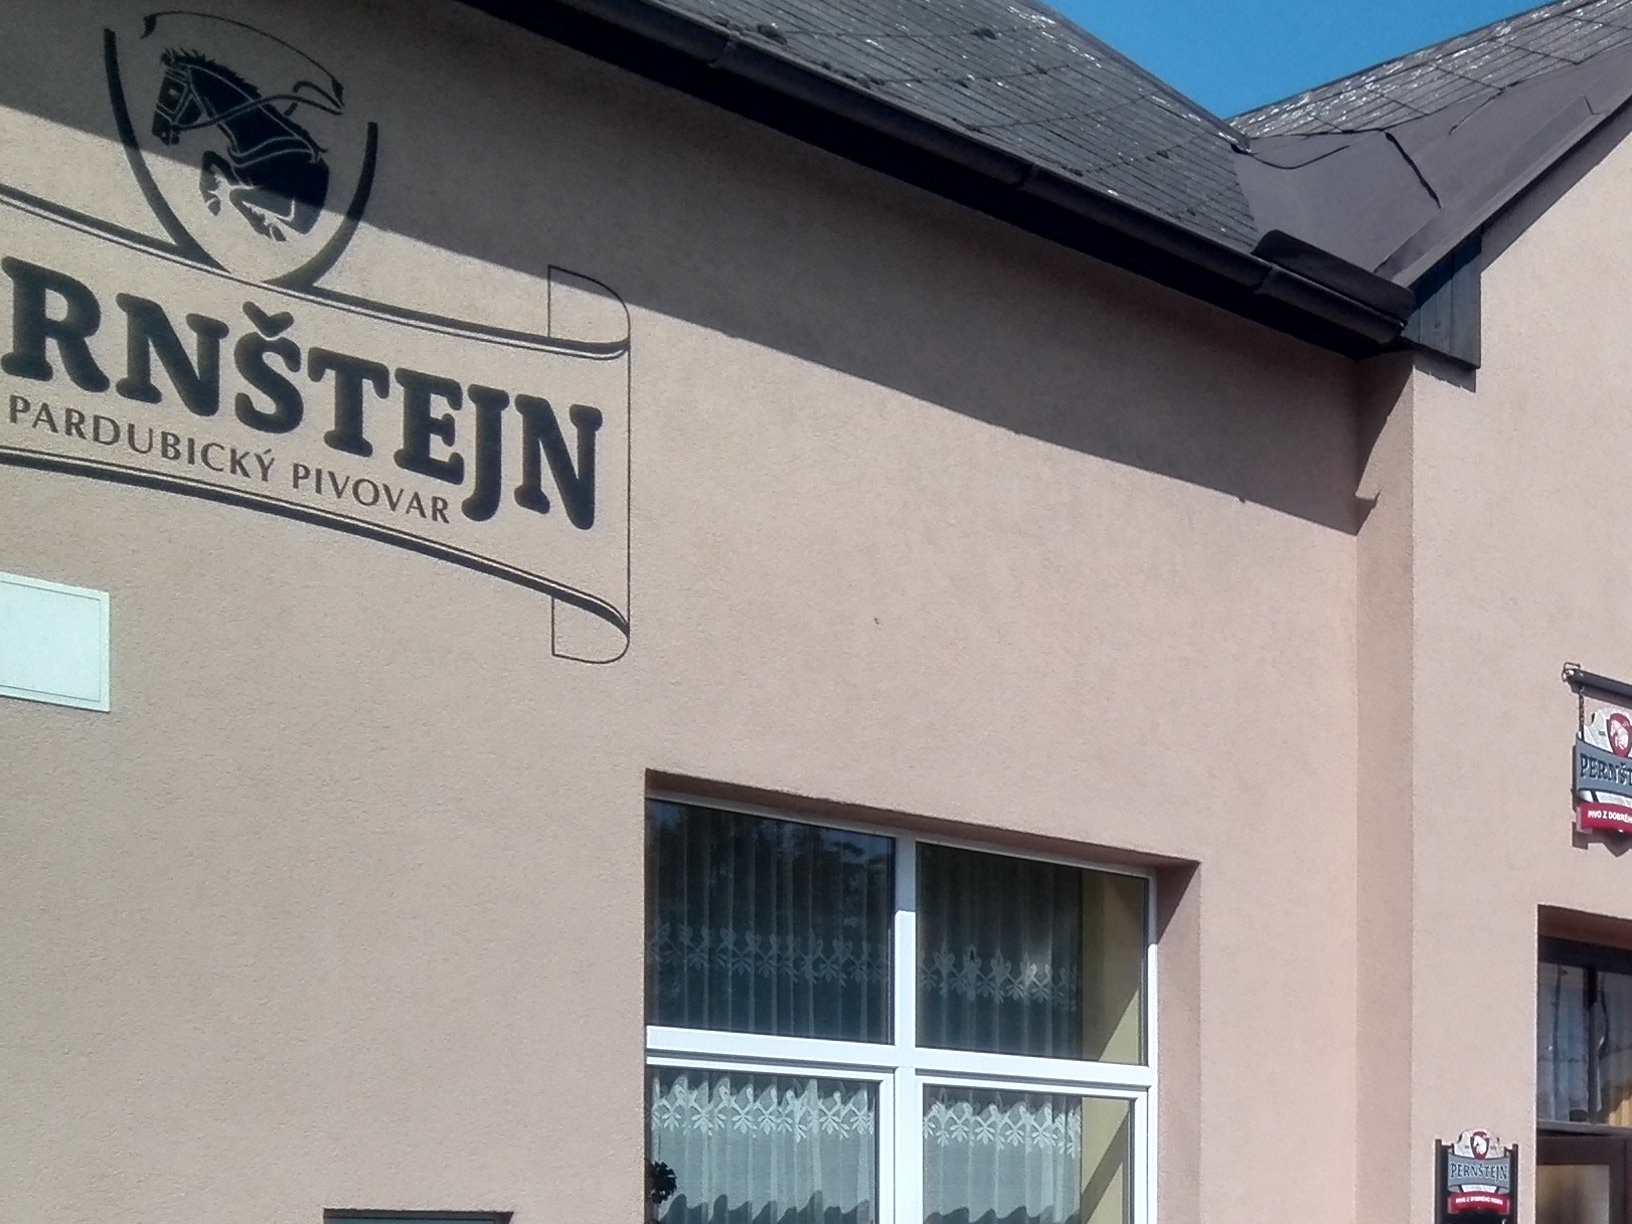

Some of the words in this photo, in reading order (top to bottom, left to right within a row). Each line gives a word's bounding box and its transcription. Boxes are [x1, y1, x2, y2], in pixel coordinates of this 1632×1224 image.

[9, 394, 275, 482] PARDUBICKÝ
[292, 462, 450, 524] PIVOVAR
[1588, 810, 1602, 819] PIVO
[1450, 1162, 1507, 1181] PERNŠTEJN
